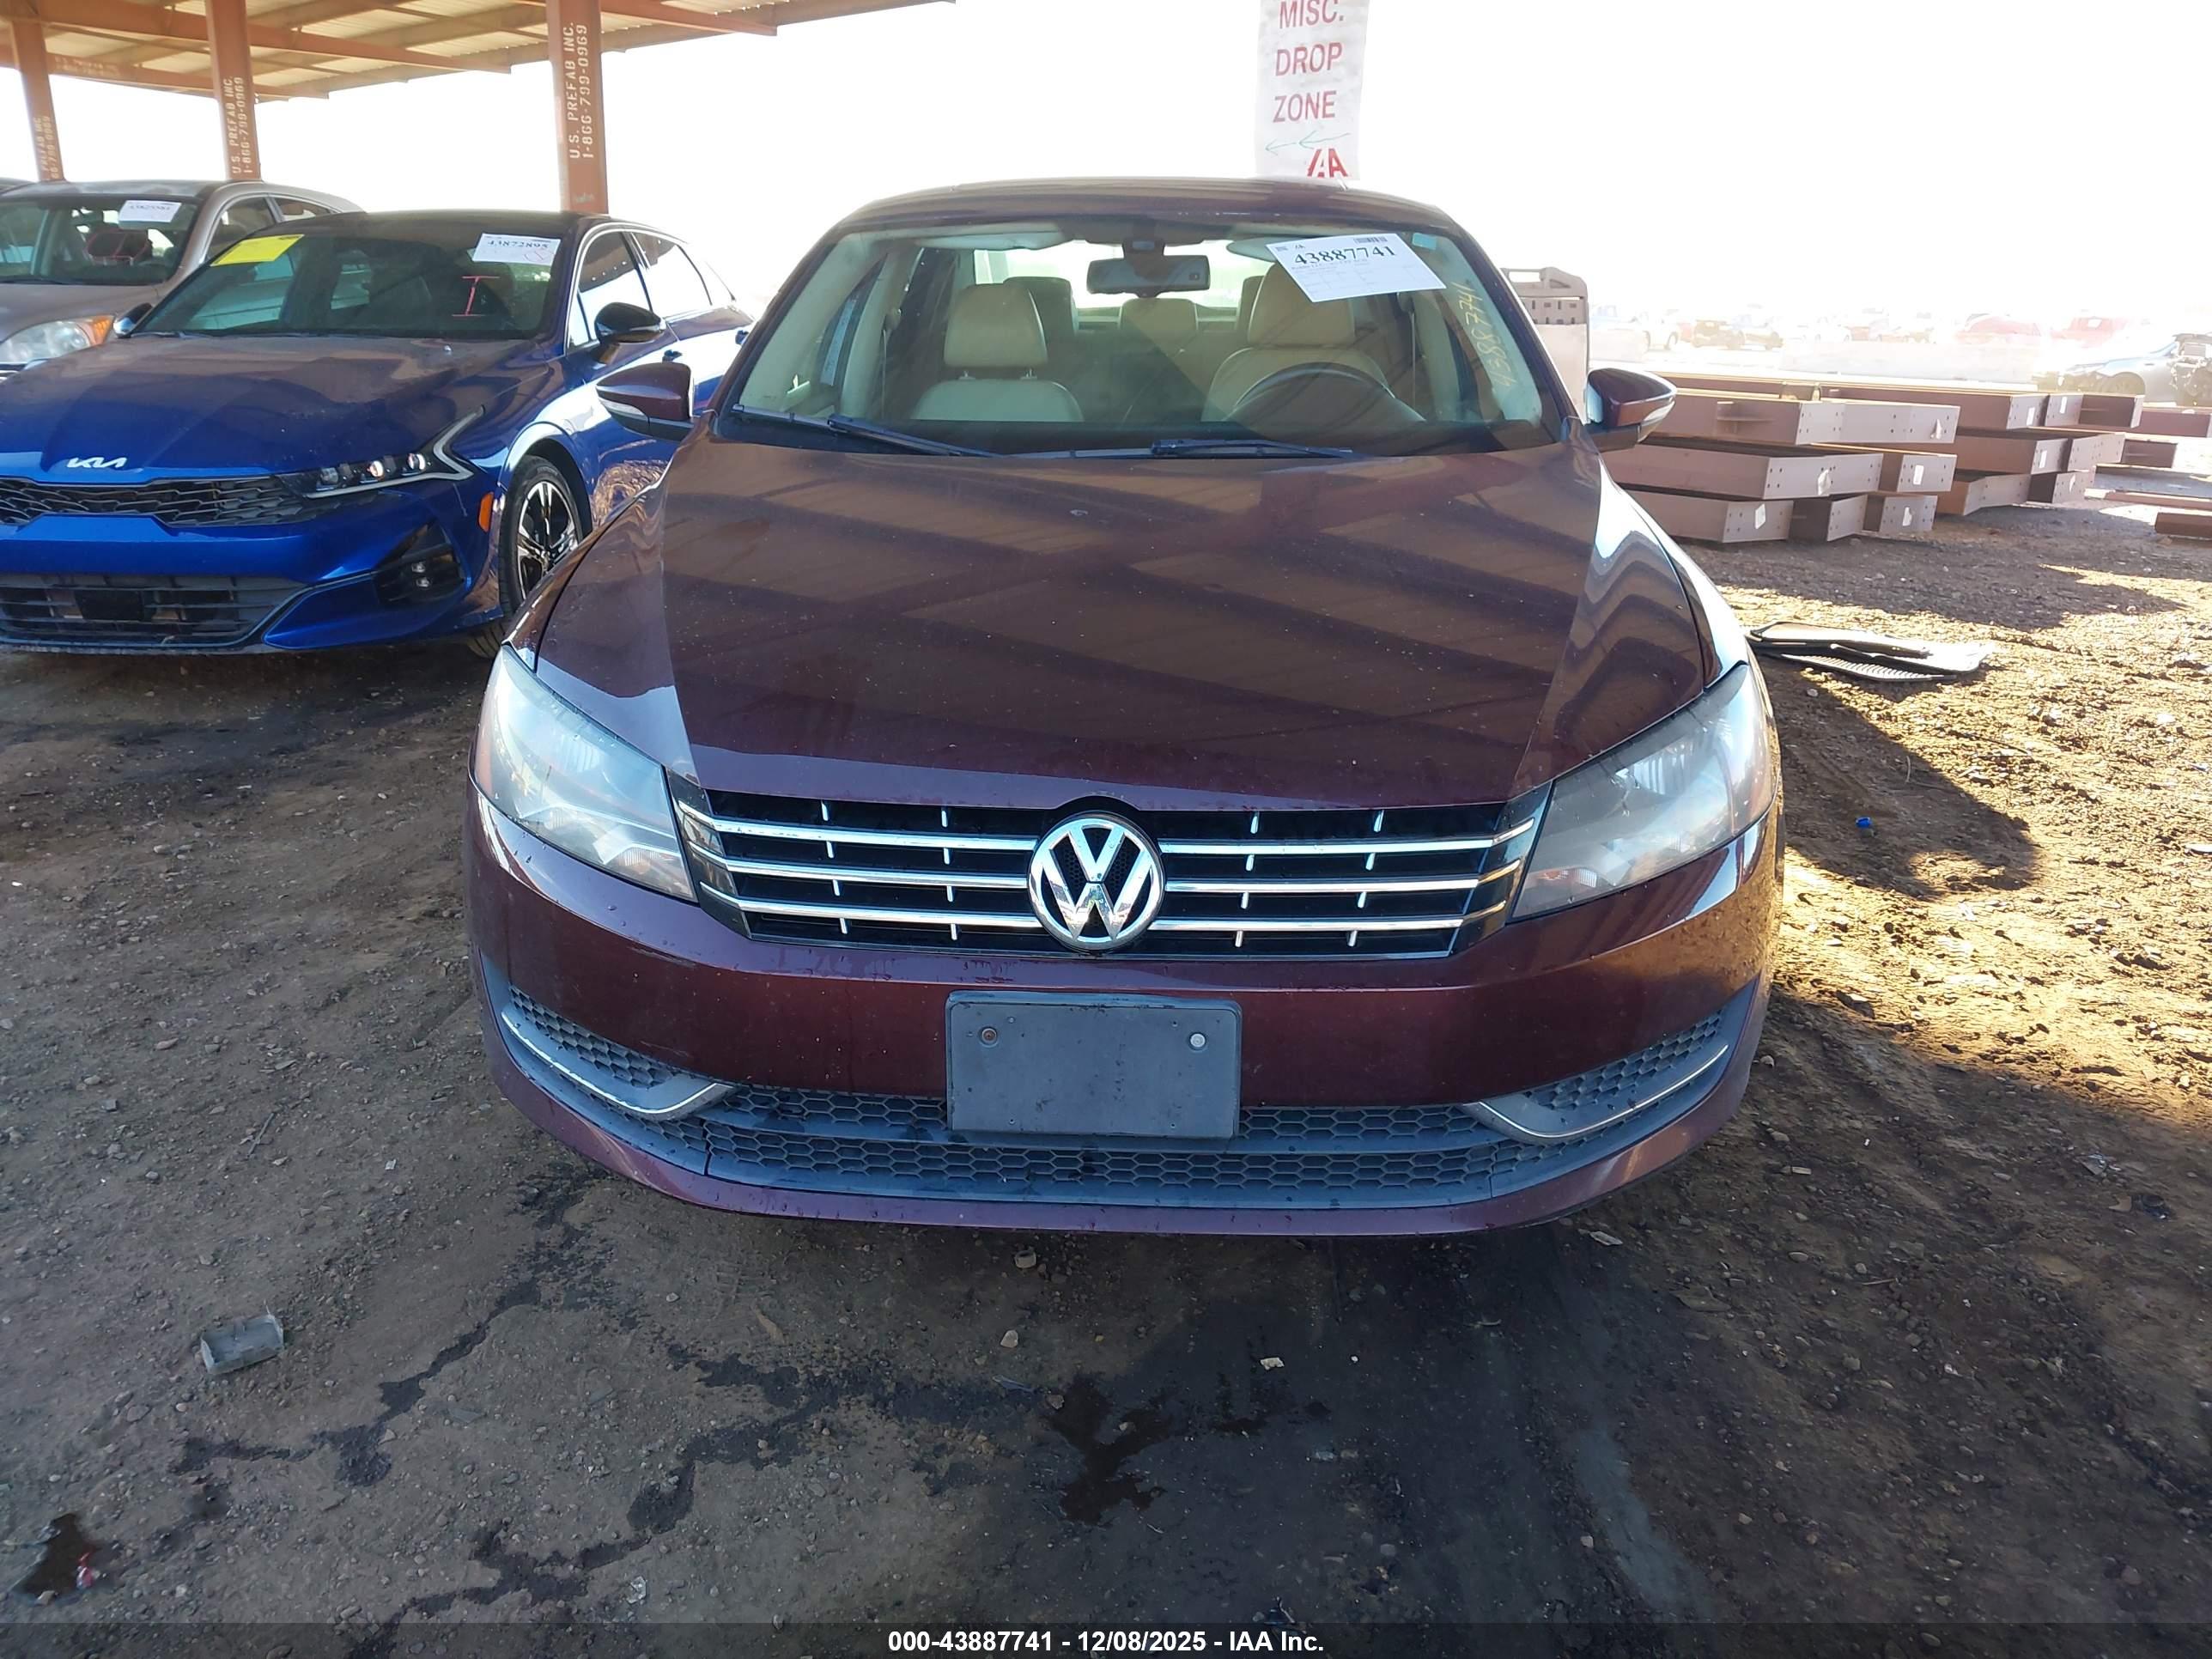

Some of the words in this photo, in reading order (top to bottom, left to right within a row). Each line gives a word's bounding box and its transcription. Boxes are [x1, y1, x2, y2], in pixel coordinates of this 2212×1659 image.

[1279, 0, 1344, 28] MISC.
[562, 22, 574, 52] INC.
[1275, 42, 1342, 76] DROP
[564, 59, 579, 121] PREFAB
[576, 24, 594, 159] 1-866-799-0969
[1273, 90, 1337, 123] ZONE
[1294, 246, 1397, 264] 43887741
[67, 457, 127, 468] KIA
